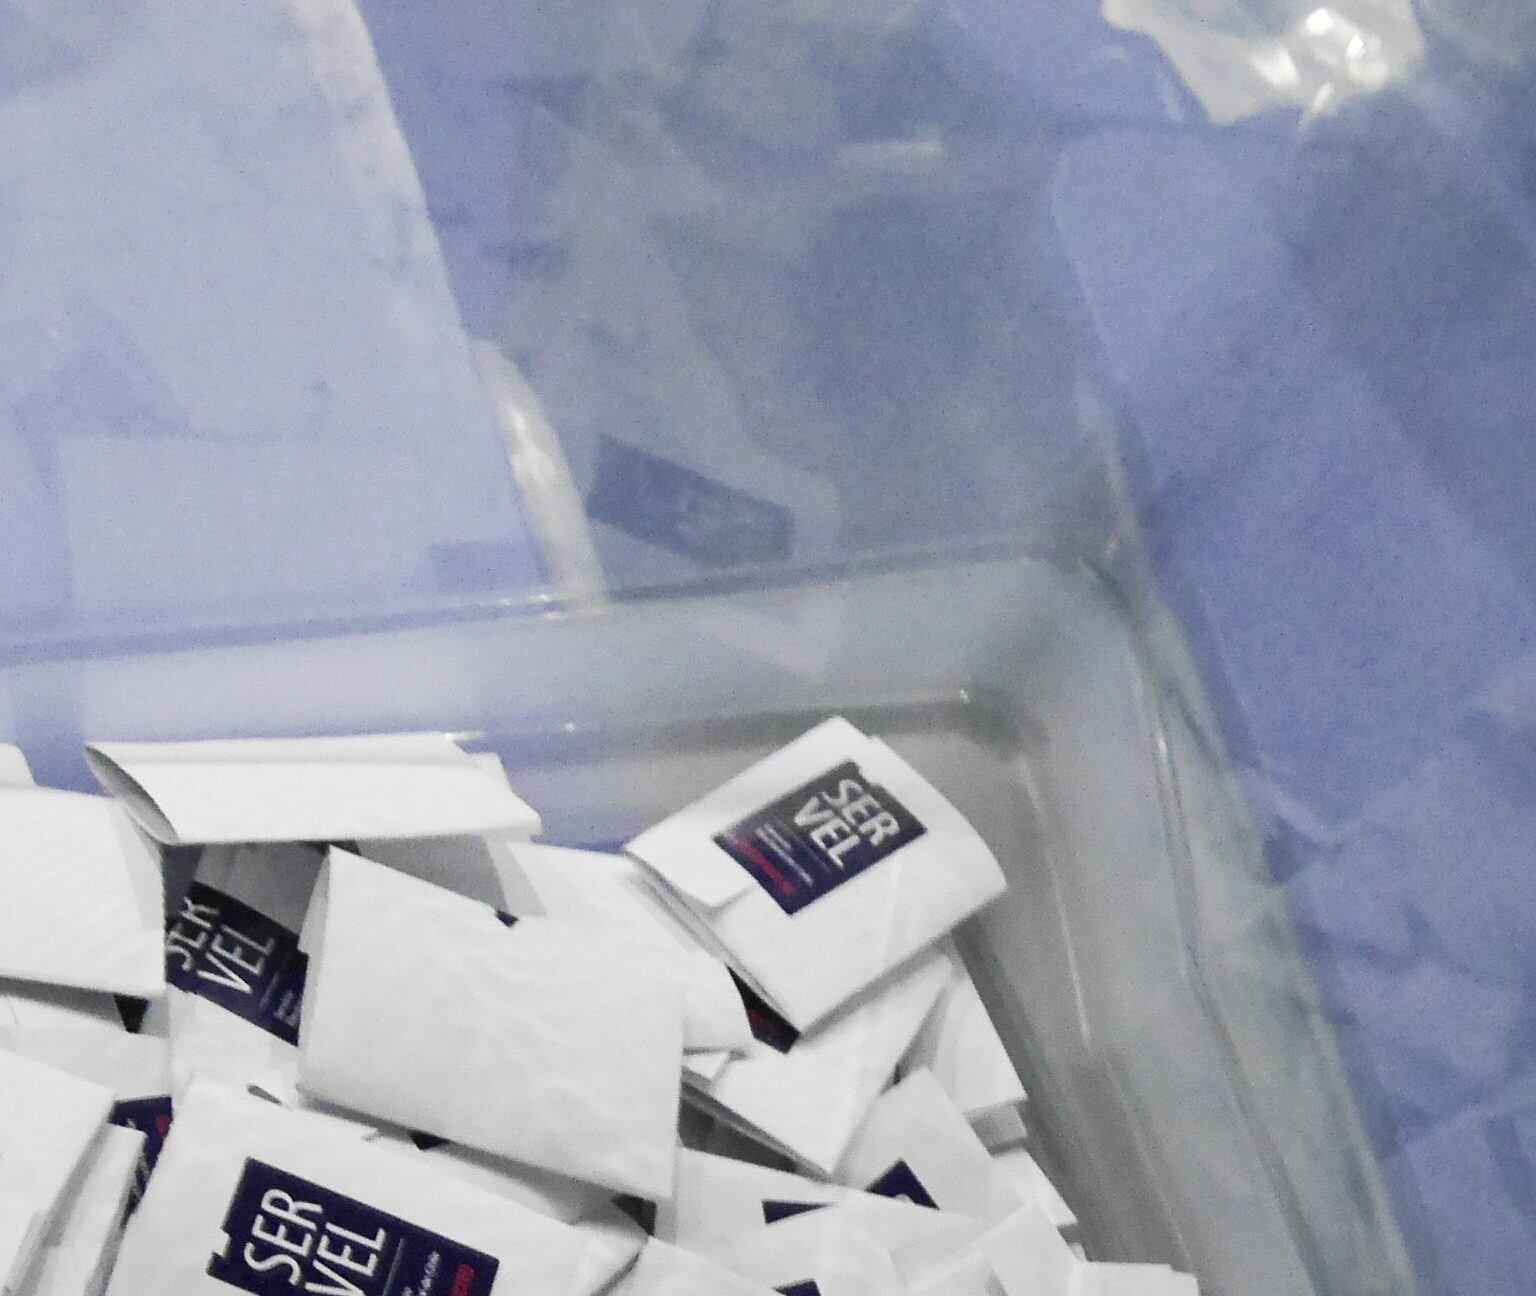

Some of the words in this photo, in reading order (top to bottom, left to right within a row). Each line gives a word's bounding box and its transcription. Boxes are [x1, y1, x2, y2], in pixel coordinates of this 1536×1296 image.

[793, 796, 861, 868] VEL
[821, 778, 900, 846] SER
[196, 927, 268, 994] VEL
[243, 1188, 323, 1286] SER
